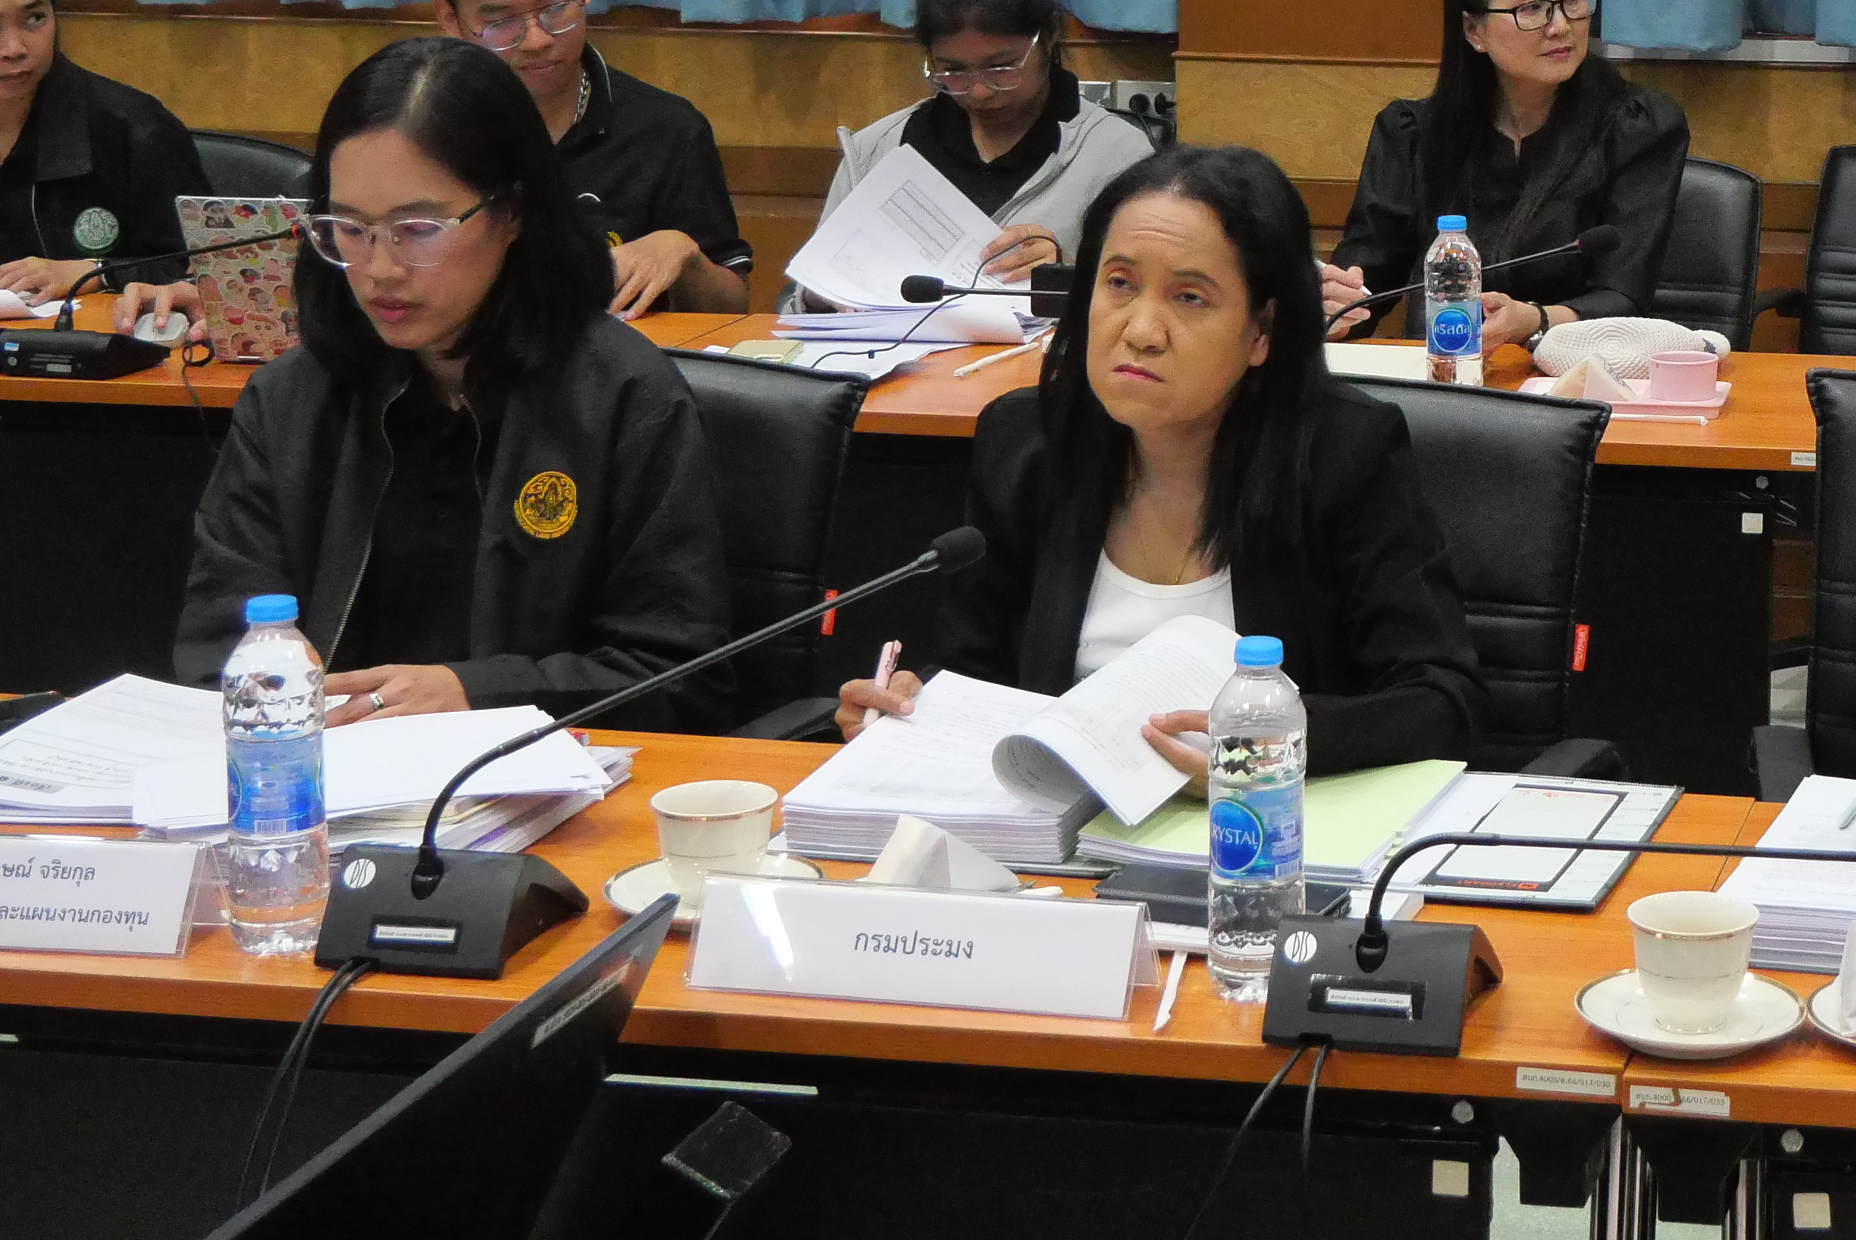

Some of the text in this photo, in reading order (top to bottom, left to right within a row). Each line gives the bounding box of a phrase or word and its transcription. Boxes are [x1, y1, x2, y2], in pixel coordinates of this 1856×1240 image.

[1211, 821, 1259, 846] RYSTAL
[0, 856, 35, 878] ษณ์
[854, 930, 974, 959] กรมประมง
